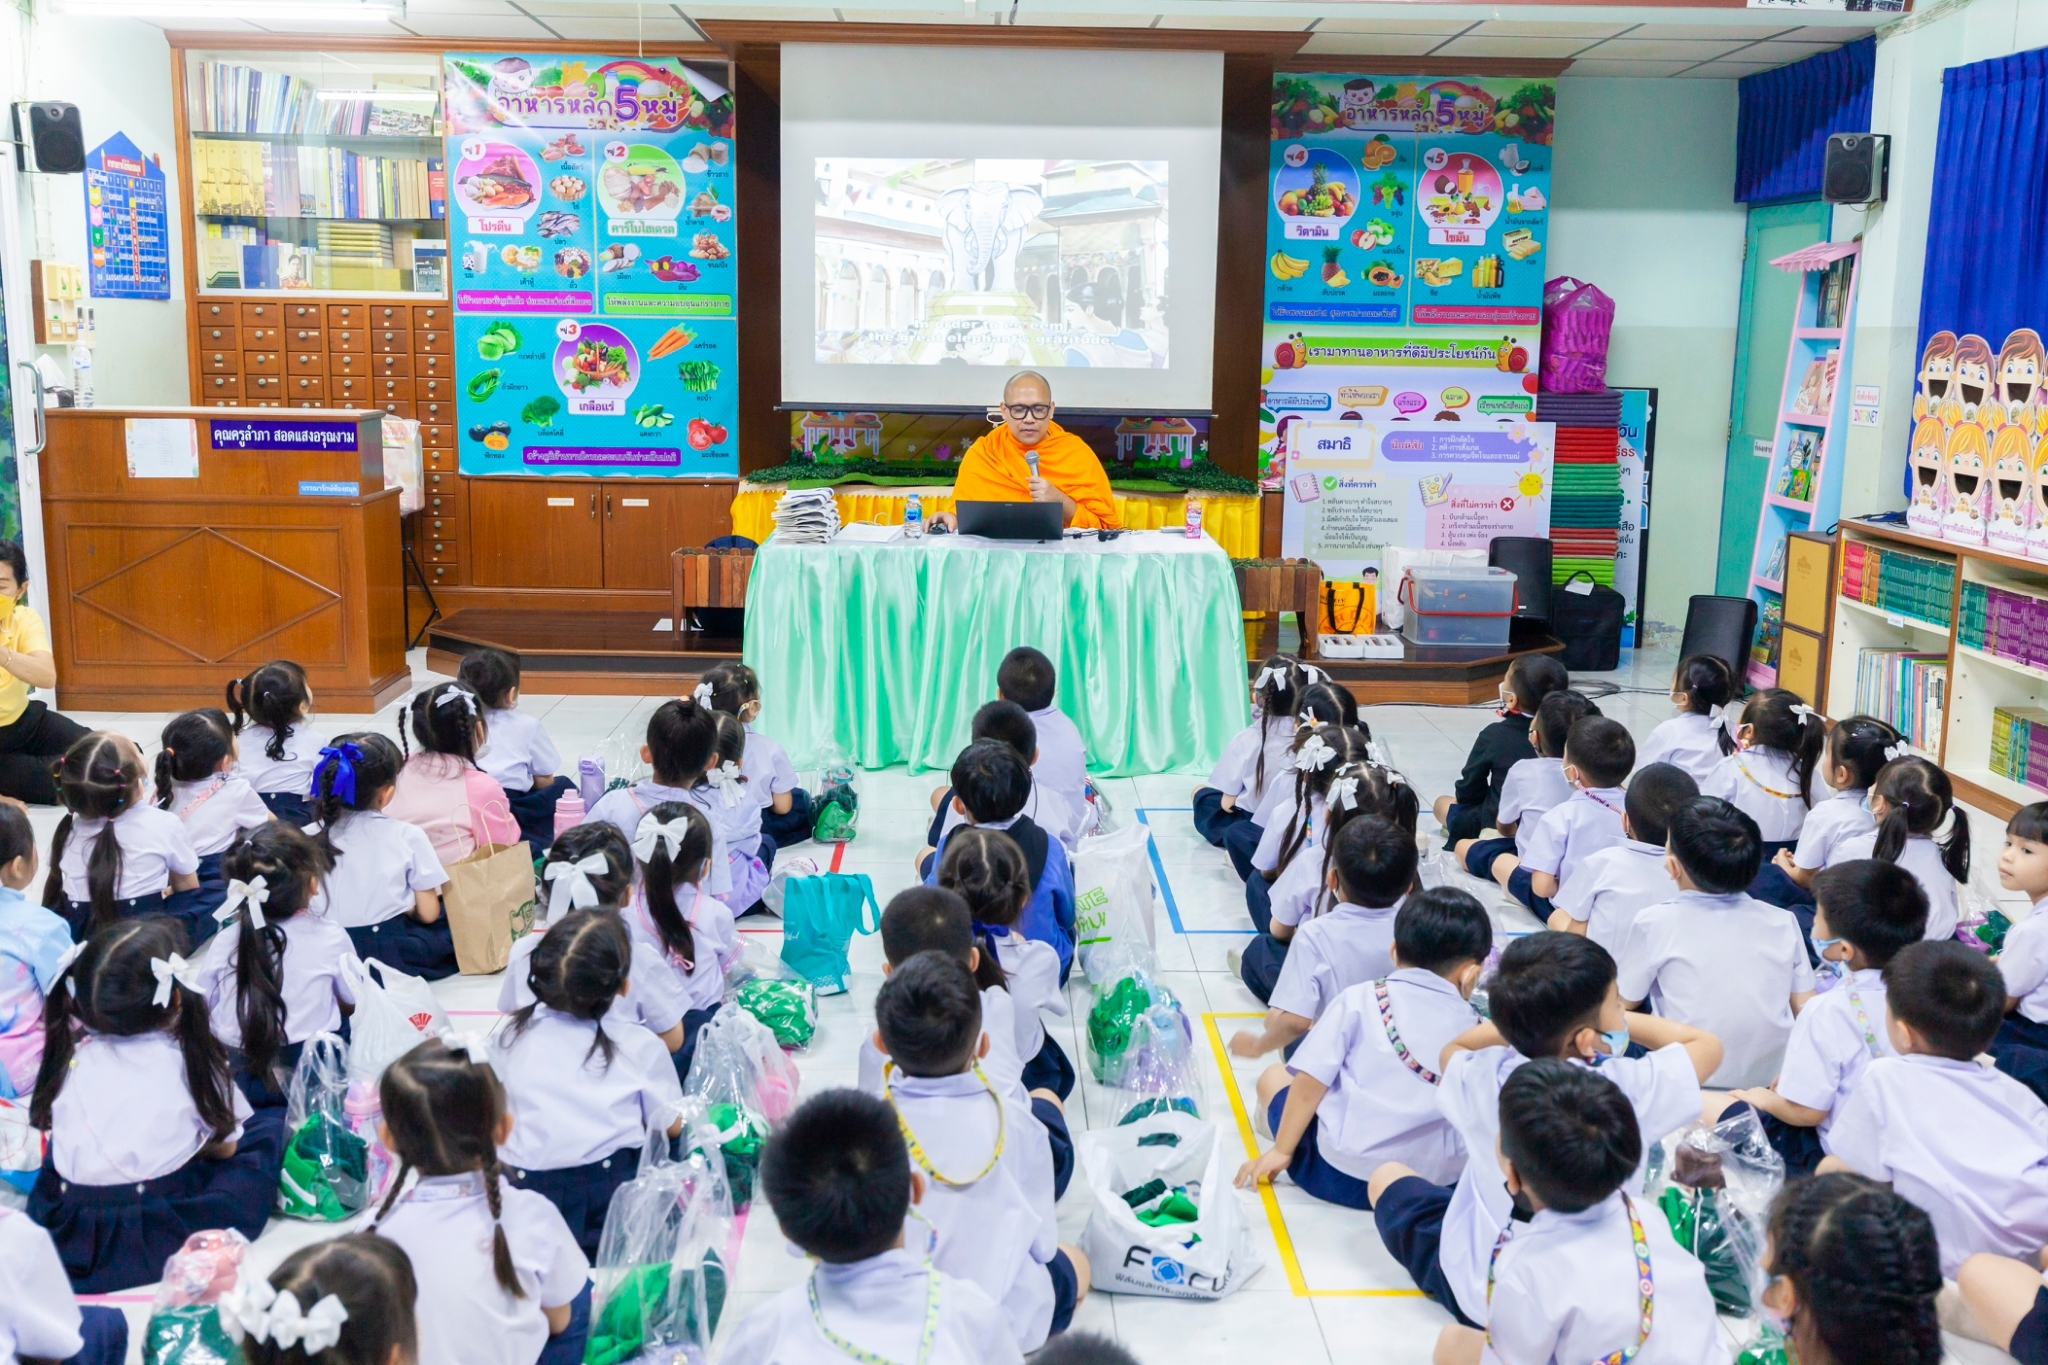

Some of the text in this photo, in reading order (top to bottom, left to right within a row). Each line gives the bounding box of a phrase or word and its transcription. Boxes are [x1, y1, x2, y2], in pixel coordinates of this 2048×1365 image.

[615, 145, 625, 157] 2
[1295, 151, 1305, 161] 4
[1435, 153, 1444, 163] 5
[479, 218, 511, 232] โปรตีน
[1295, 224, 1329, 237] วิตามิน
[1444, 229, 1470, 243] ไขมัน
[568, 324, 577, 335] 3
[914, 319, 1064, 331] In order to eseem
[868, 332, 1116, 346] the great elephant's gratitude,
[1308, 342, 1496, 360] เรามาทานอาหารที่ดีมีประโยชน์กัน
[579, 400, 614, 412] เกลือแร่
[1854, 409, 1879, 423] INTERNET
[214, 424, 355, 449] คุณครูลำภา สอดแสงอรุณงาม
[1317, 436, 1352, 450] สมาธิ
[1339, 477, 1377, 488] สิ่งที่ควรทำ
[301, 484, 357, 494] บรรณารักษ์ห้องสมุด
[1450, 498, 1498, 509] สิ่งที่ไม่ควรทำ
